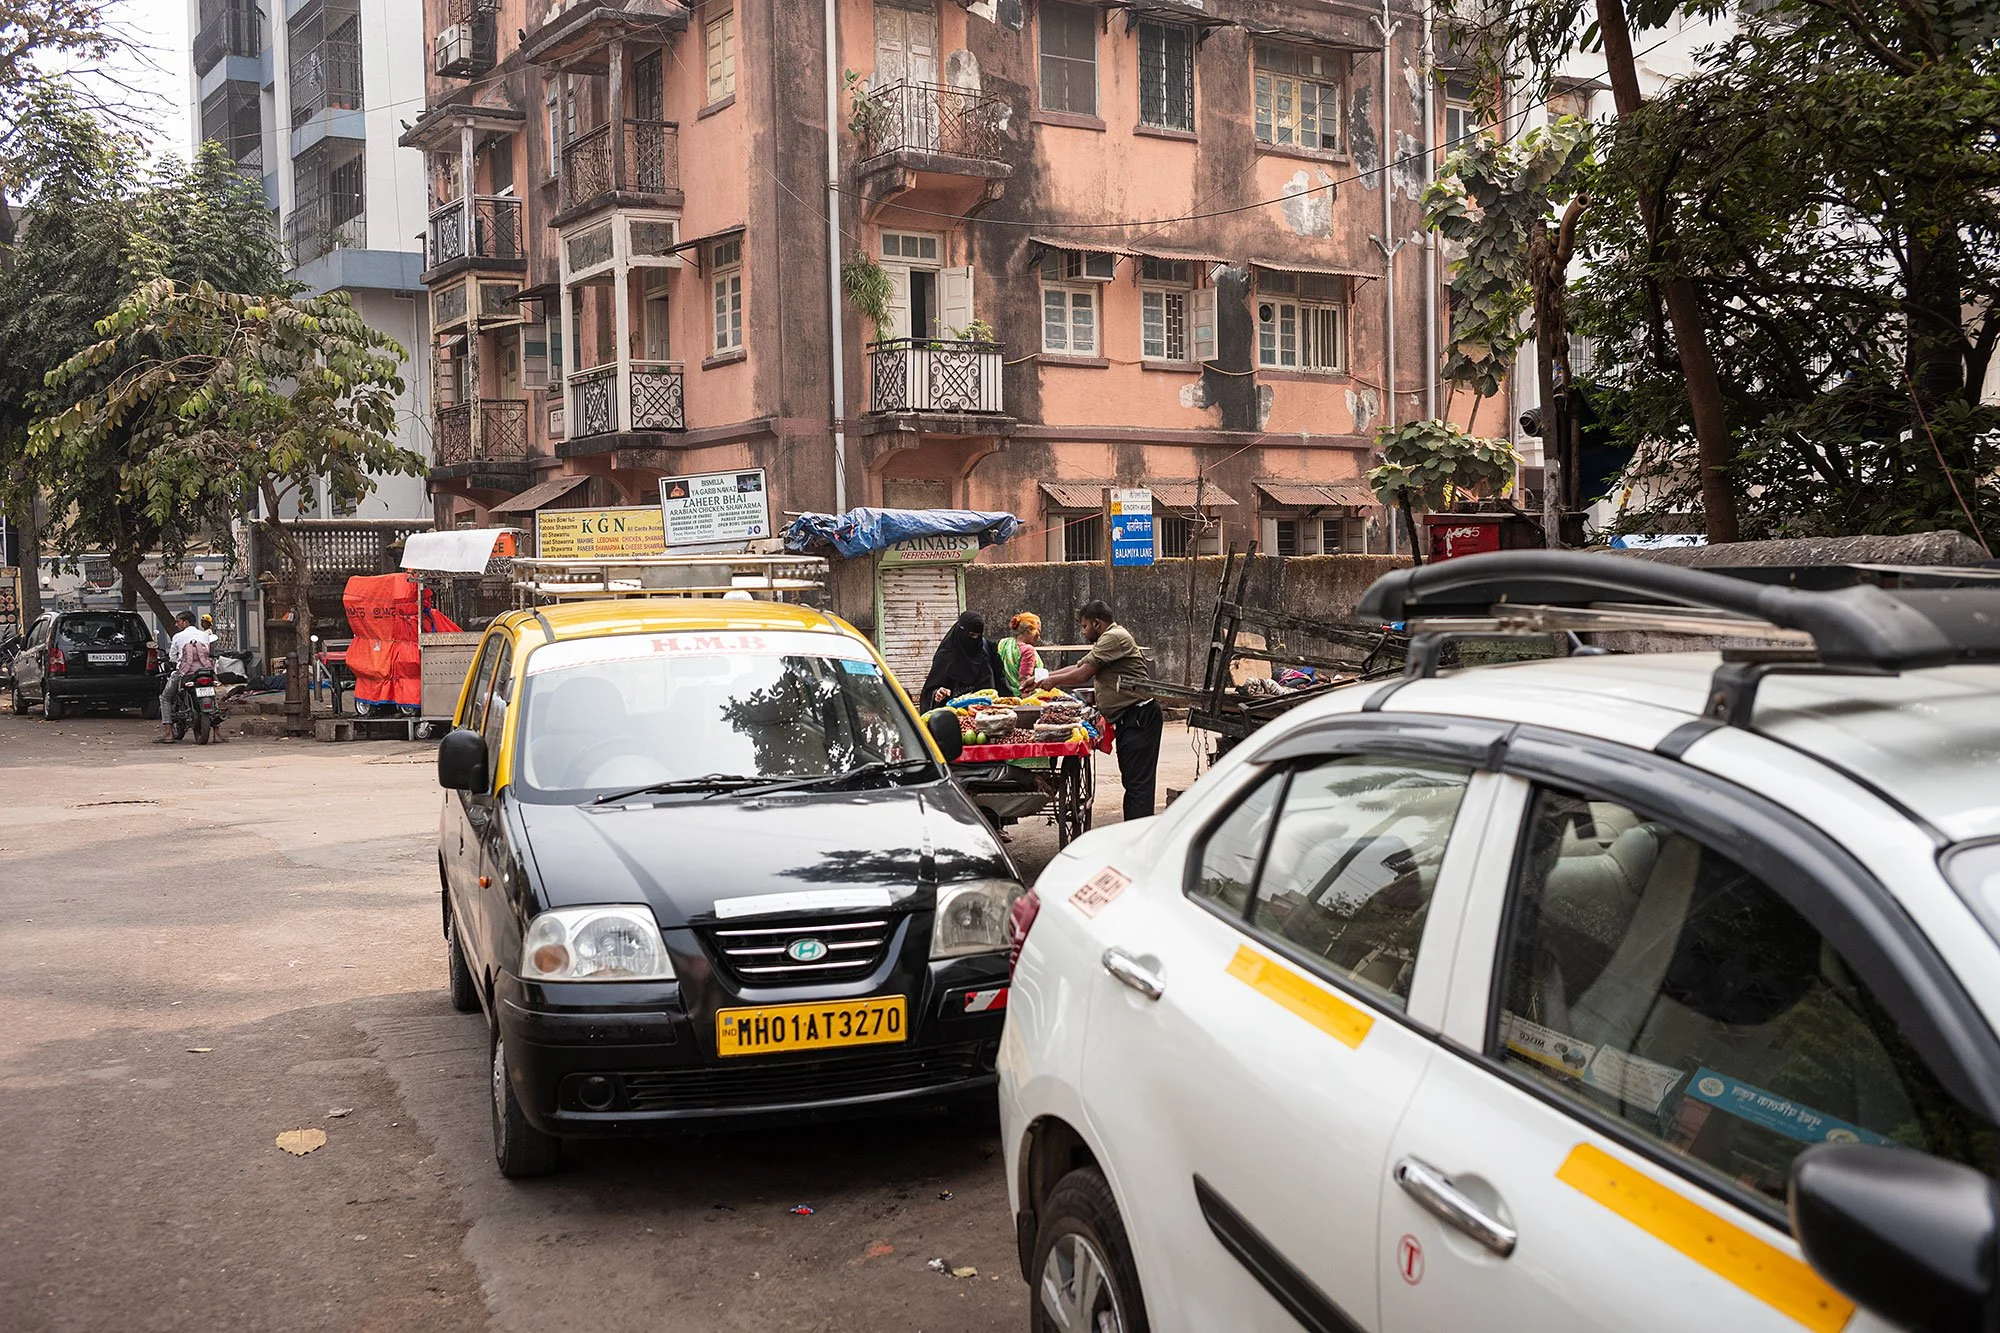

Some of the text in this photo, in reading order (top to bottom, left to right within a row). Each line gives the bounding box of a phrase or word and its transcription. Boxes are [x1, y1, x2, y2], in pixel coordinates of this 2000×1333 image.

[700, 488, 716, 496] GARIB
[683, 494, 746, 508] ZAHEER BHAI
[670, 507, 697, 516] ARABIAN
[698, 505, 725, 513] CHICKEN
[900, 551, 961, 559] REFRESHMENTS
[1140, 548, 1152, 558] LANE
[651, 636, 766, 652] H.M.B
[738, 1006, 900, 1046] MH01AT3270
[722, 1029, 737, 1037] IND
